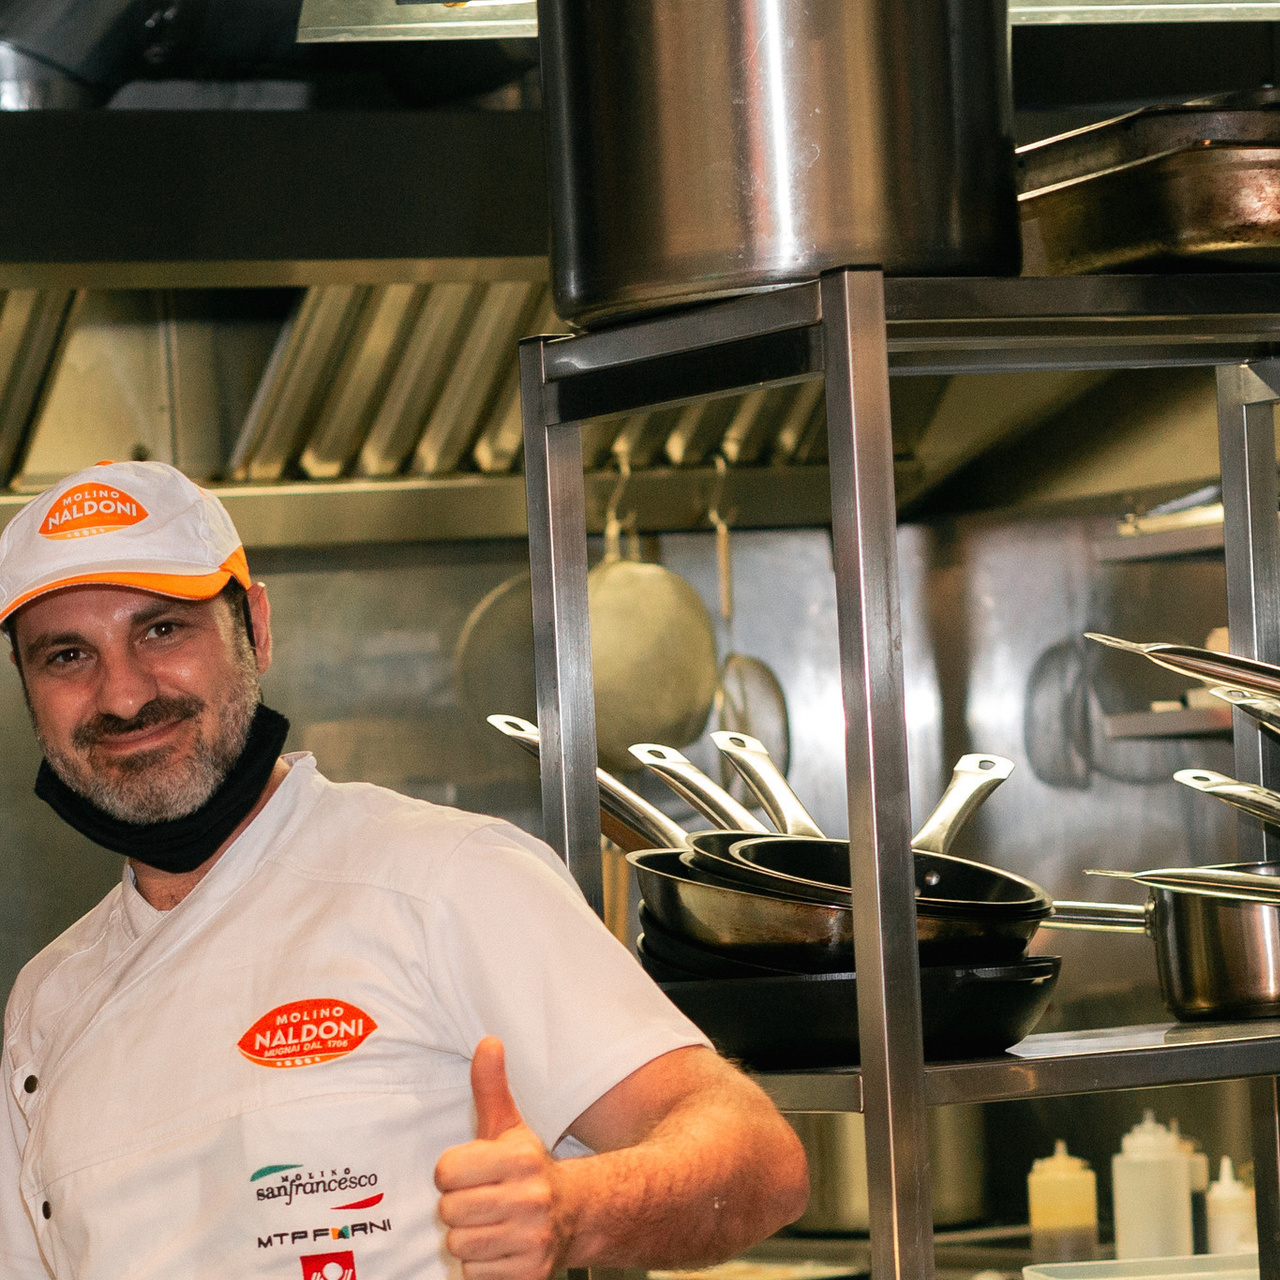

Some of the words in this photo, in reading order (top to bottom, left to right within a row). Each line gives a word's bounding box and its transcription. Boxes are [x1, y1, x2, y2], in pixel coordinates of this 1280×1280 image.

[63, 490, 120, 506] MOLINO
[48, 500, 137, 530] NALDONI
[276, 1006, 344, 1026] MOLINO
[255, 1018, 363, 1050] NALDONI
[264, 1044, 300, 1058] MUGNAI
[303, 1041, 322, 1051] DAL
[281, 1167, 351, 1182] MOLINO
